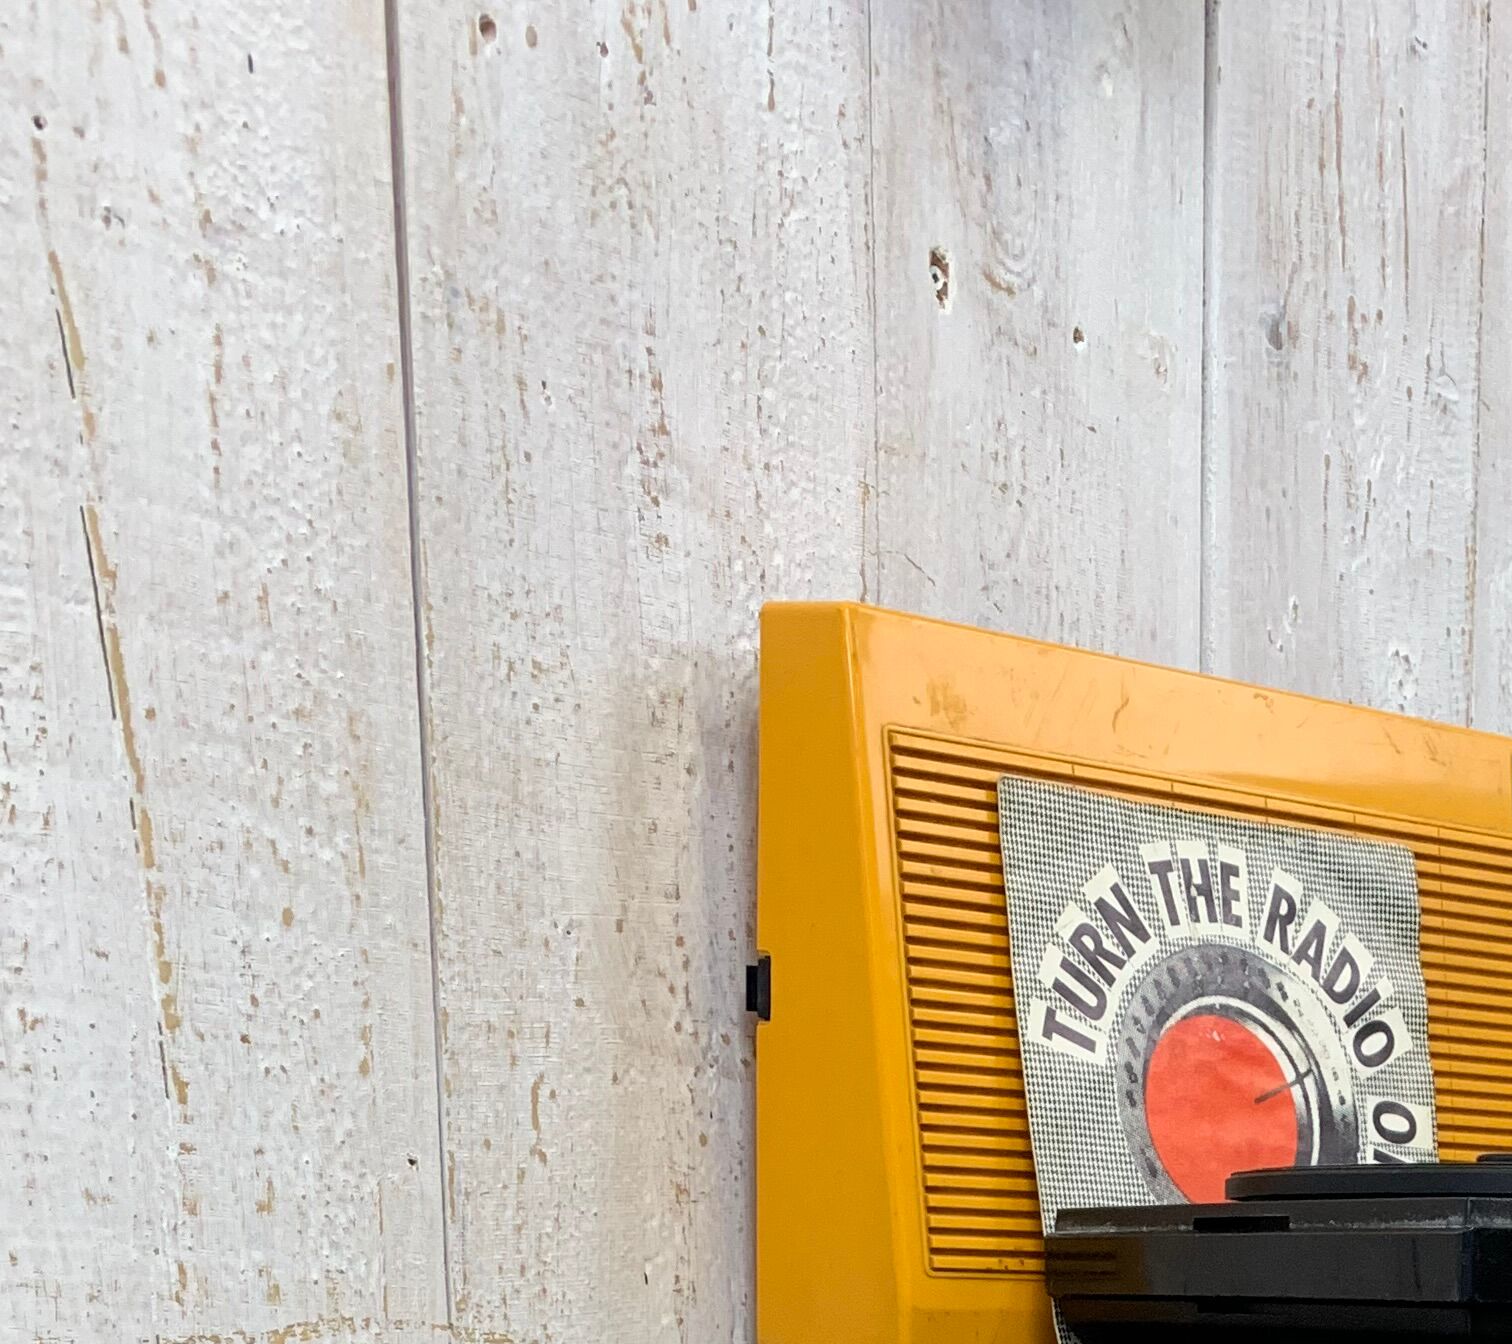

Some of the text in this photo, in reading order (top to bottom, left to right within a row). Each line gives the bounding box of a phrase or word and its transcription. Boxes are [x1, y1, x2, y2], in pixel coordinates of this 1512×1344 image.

[1042, 882, 1153, 1055] TURN
[1149, 857, 1245, 928] THE
[1262, 882, 1396, 1069] RADIO
[1371, 1099, 1418, 1163] O
